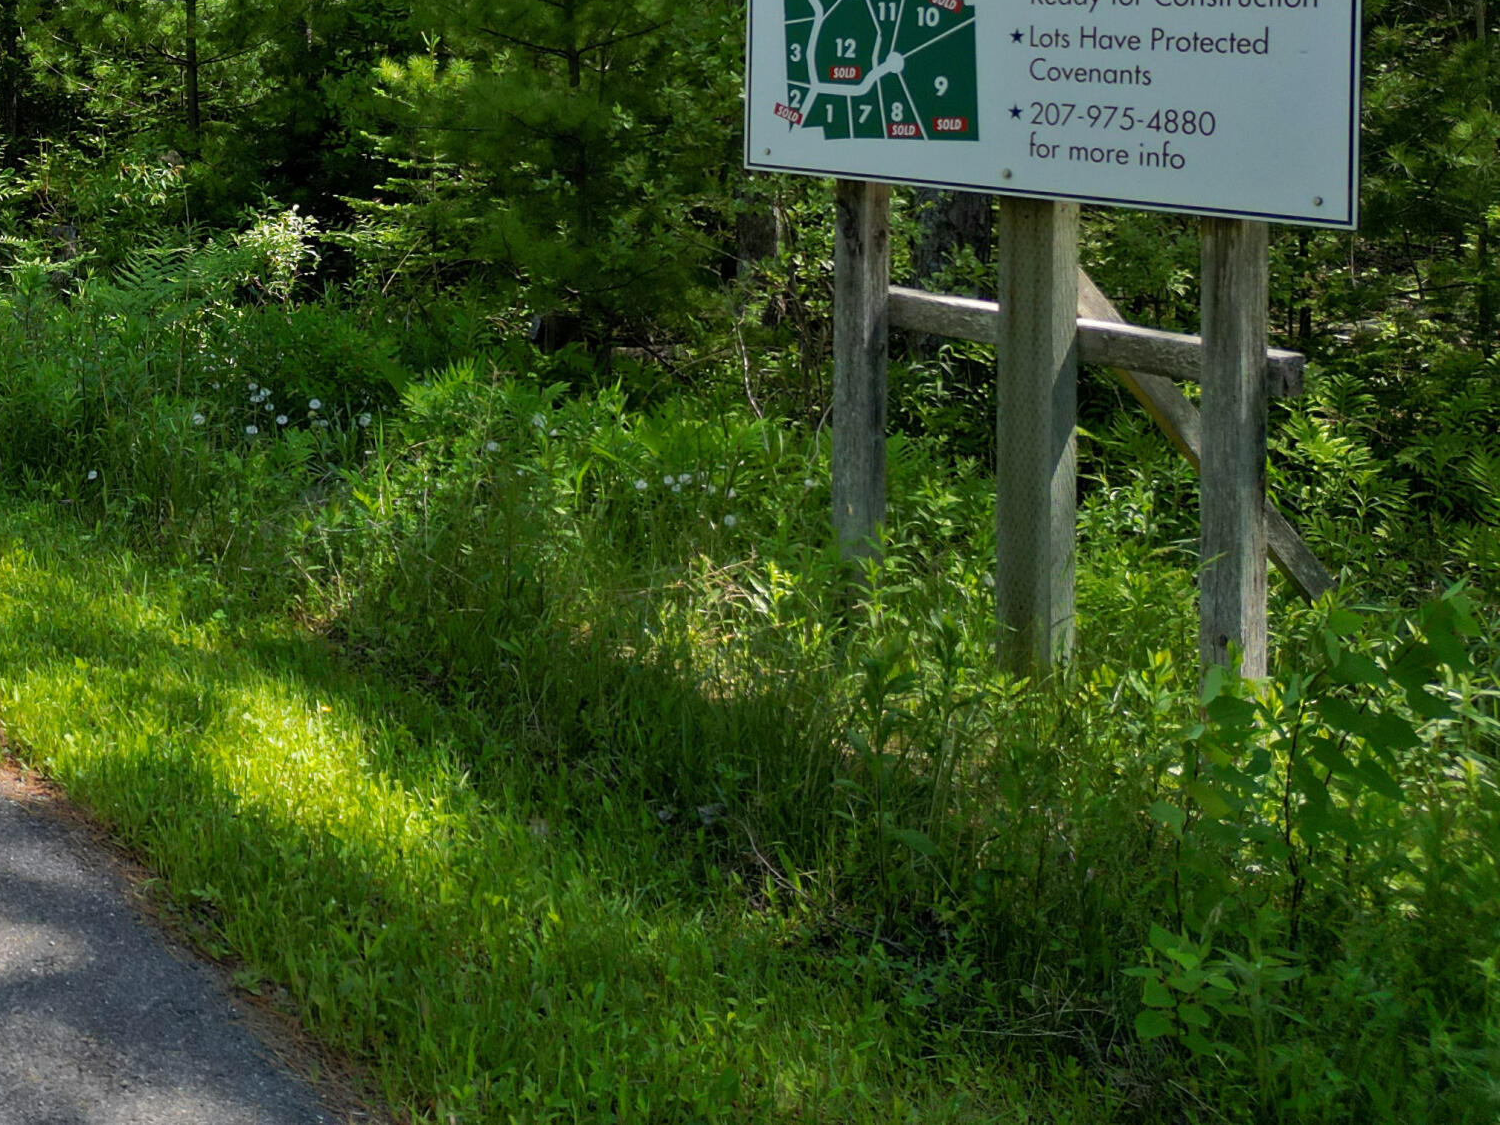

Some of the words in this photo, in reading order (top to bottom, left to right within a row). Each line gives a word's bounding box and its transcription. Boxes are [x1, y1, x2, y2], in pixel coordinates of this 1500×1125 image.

[878, 2, 896, 21] 11
[917, 7, 939, 27] 10
[835, 38, 856, 58] 12
[1029, 25, 1070, 48] Lots
[1080, 26, 1141, 51] Have
[1151, 26, 1269, 55] Protected
[790, 43, 801, 62] 3
[833, 67, 856, 79] SOLD
[1029, 58, 1152, 86] Covenants
[934, 76, 948, 96] 9
[790, 89, 801, 108] 2
[776, 104, 800, 122] SOLD
[826, 104, 833, 123] 1
[859, 105, 872, 123] 7
[891, 102, 904, 122] 8
[1030, 101, 1215, 136] 207-975-4880
[891, 125, 915, 136] SOLD
[936, 118, 961, 130] SOLD
[1029, 131, 1059, 159] for
[1069, 145, 1129, 165] more
[1139, 140, 1186, 169] info
